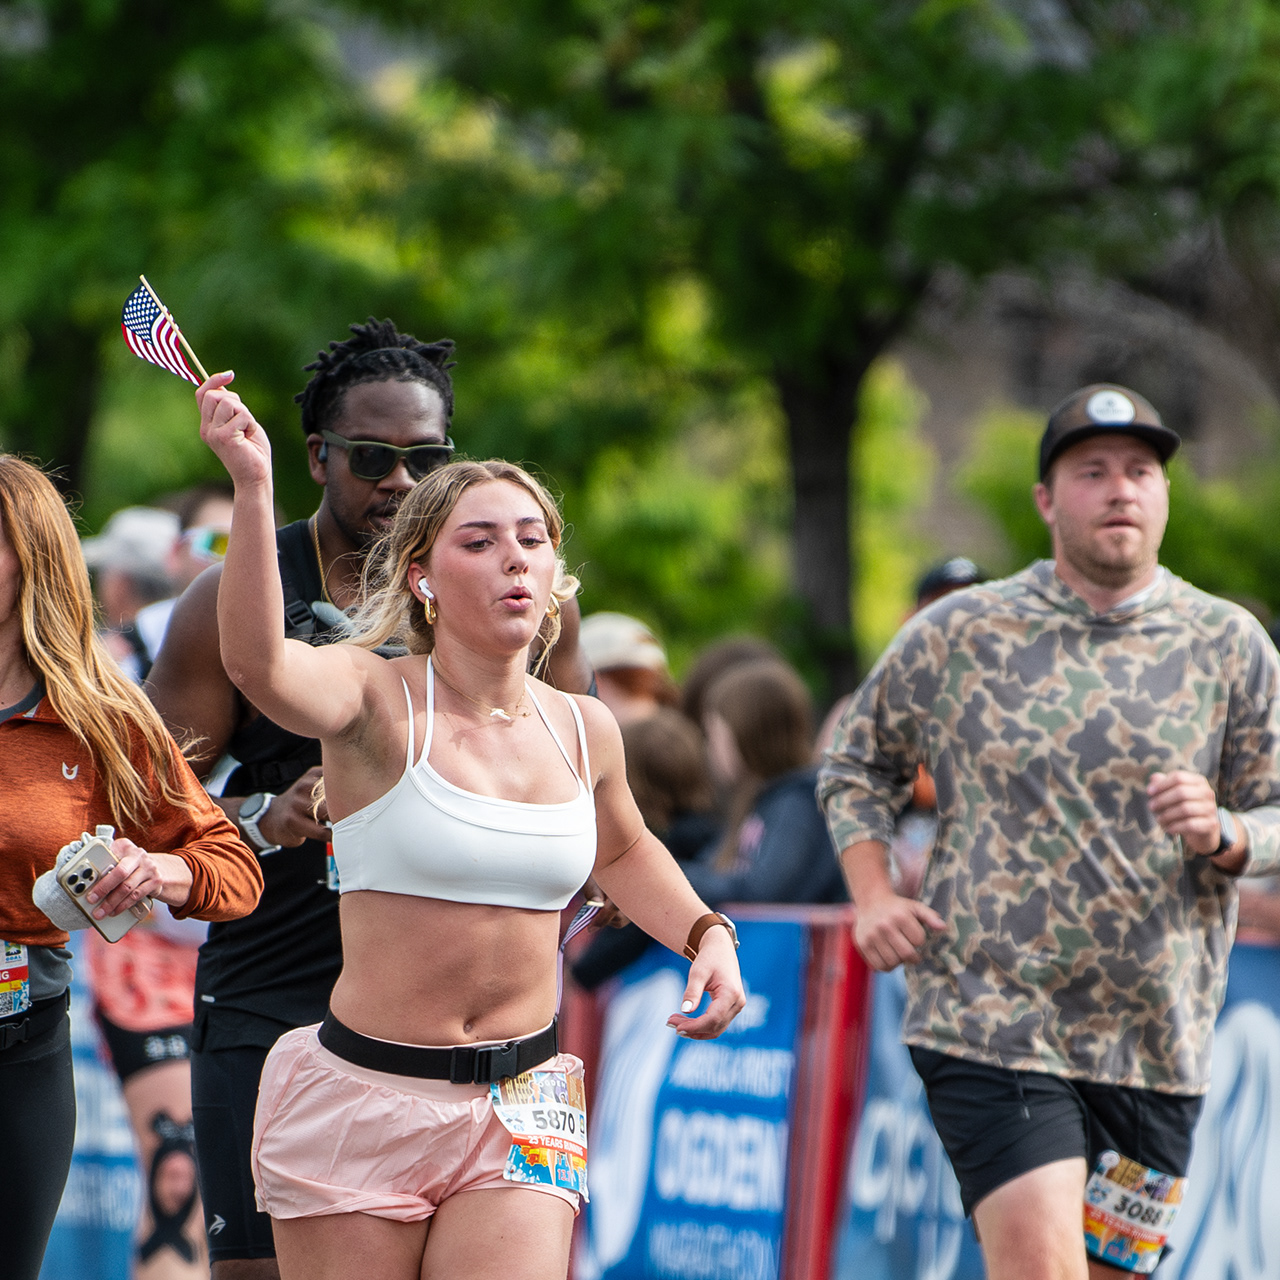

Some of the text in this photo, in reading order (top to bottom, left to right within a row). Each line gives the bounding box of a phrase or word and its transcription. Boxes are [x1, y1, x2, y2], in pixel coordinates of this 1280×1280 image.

[531, 1109, 575, 1135] 5870
[527, 1135, 539, 1144] 25
[540, 1136, 564, 1149] YEARS
